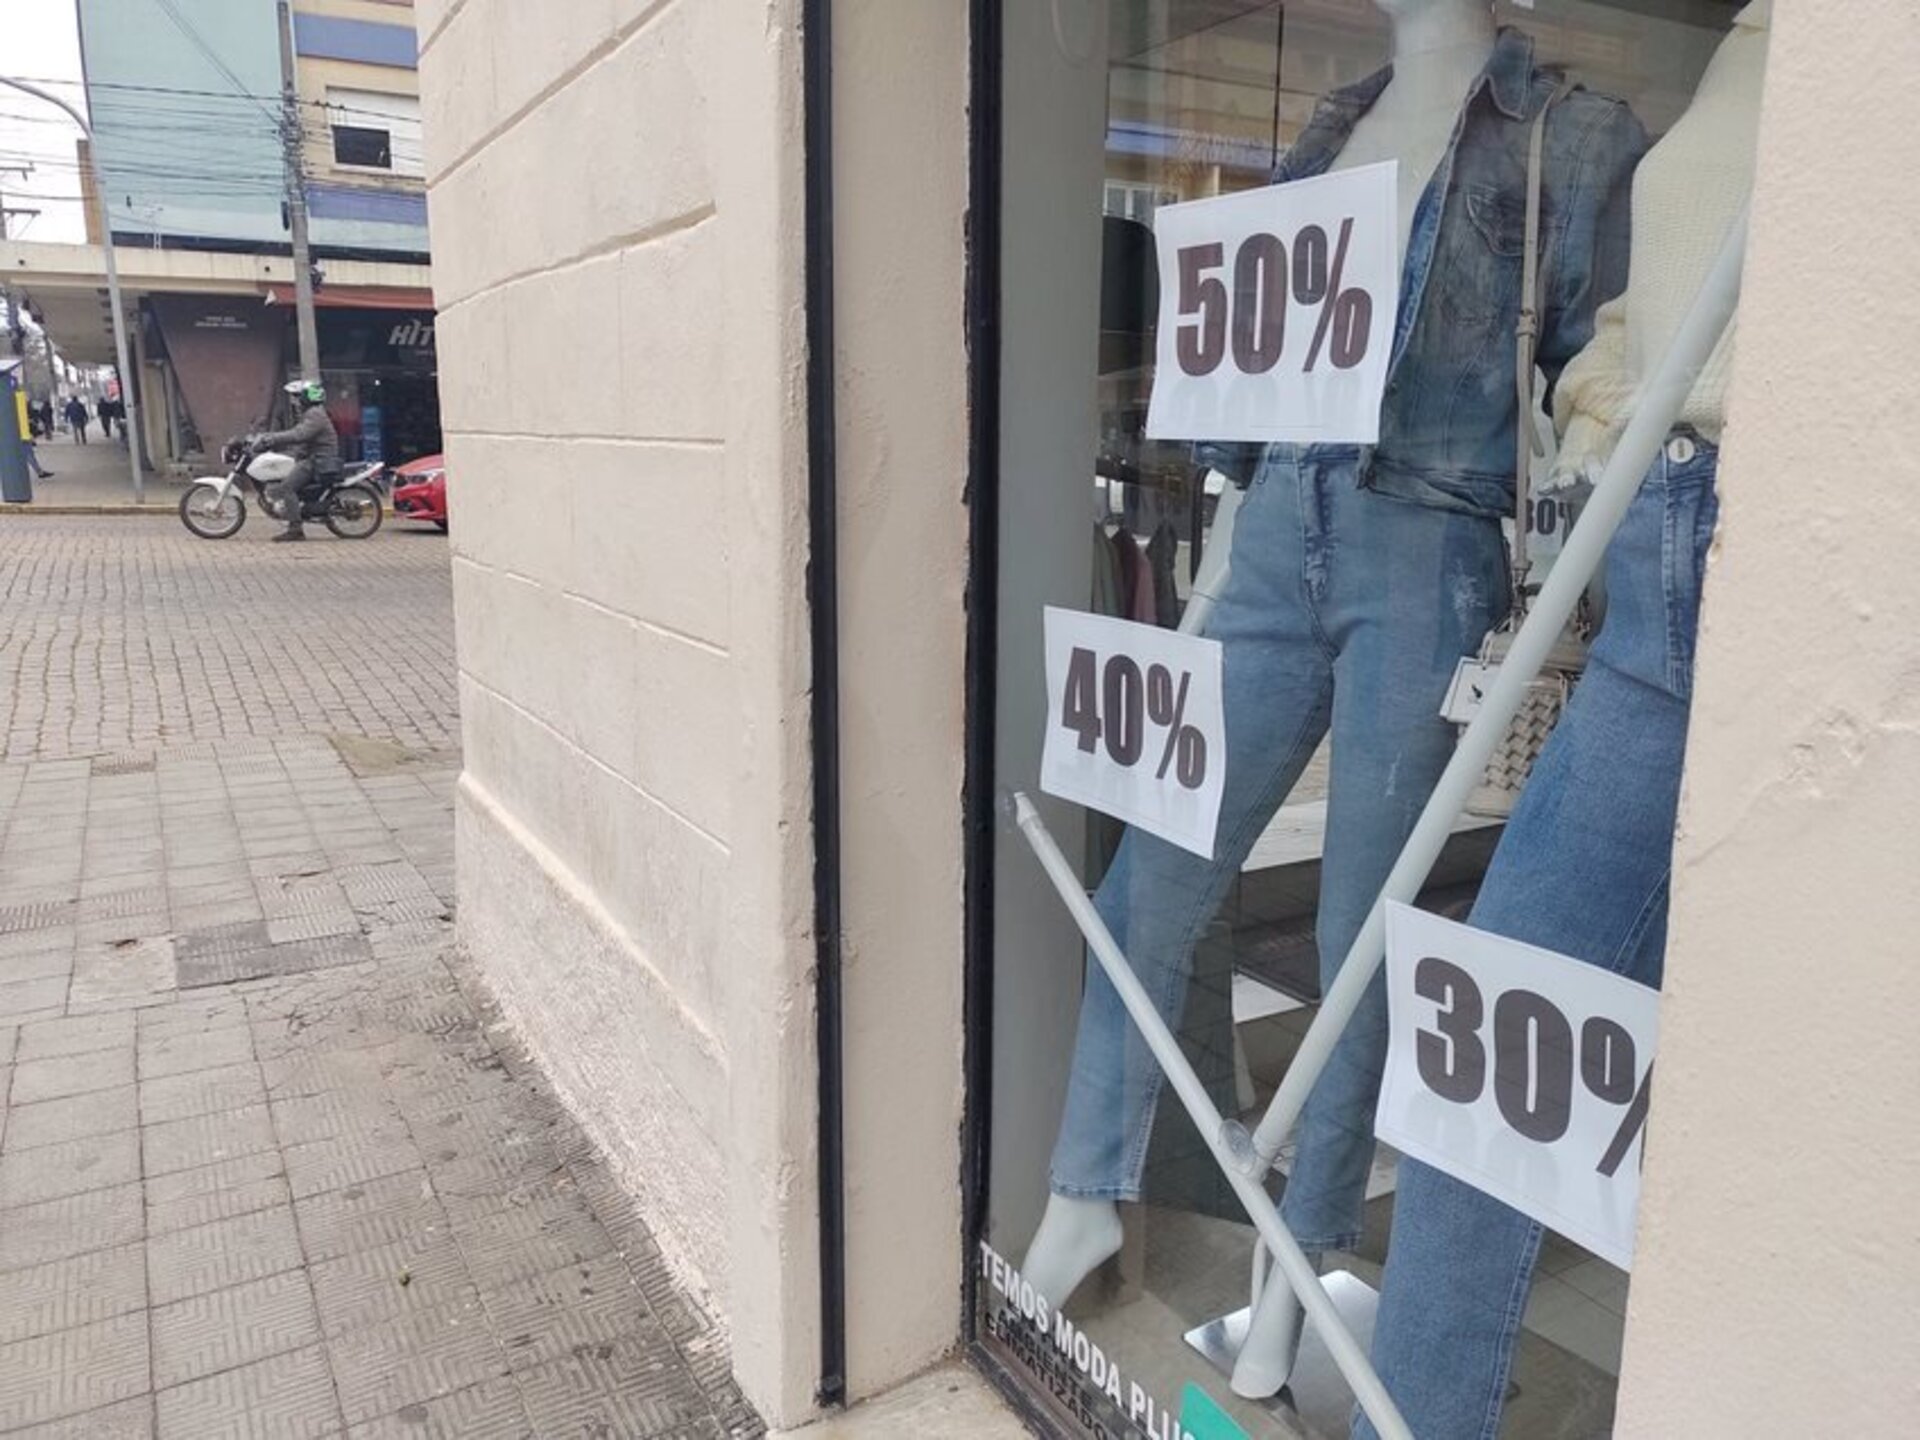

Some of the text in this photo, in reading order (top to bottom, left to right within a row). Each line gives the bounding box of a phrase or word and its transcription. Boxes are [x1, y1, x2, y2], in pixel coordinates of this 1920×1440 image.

[1176, 217, 1373, 377] 50%
[1062, 646, 1207, 790] 40%
[980, 1239, 1049, 1334] TEMOS
[1055, 1309, 1122, 1409] MODA
[1130, 1380, 1197, 1440] PLU
